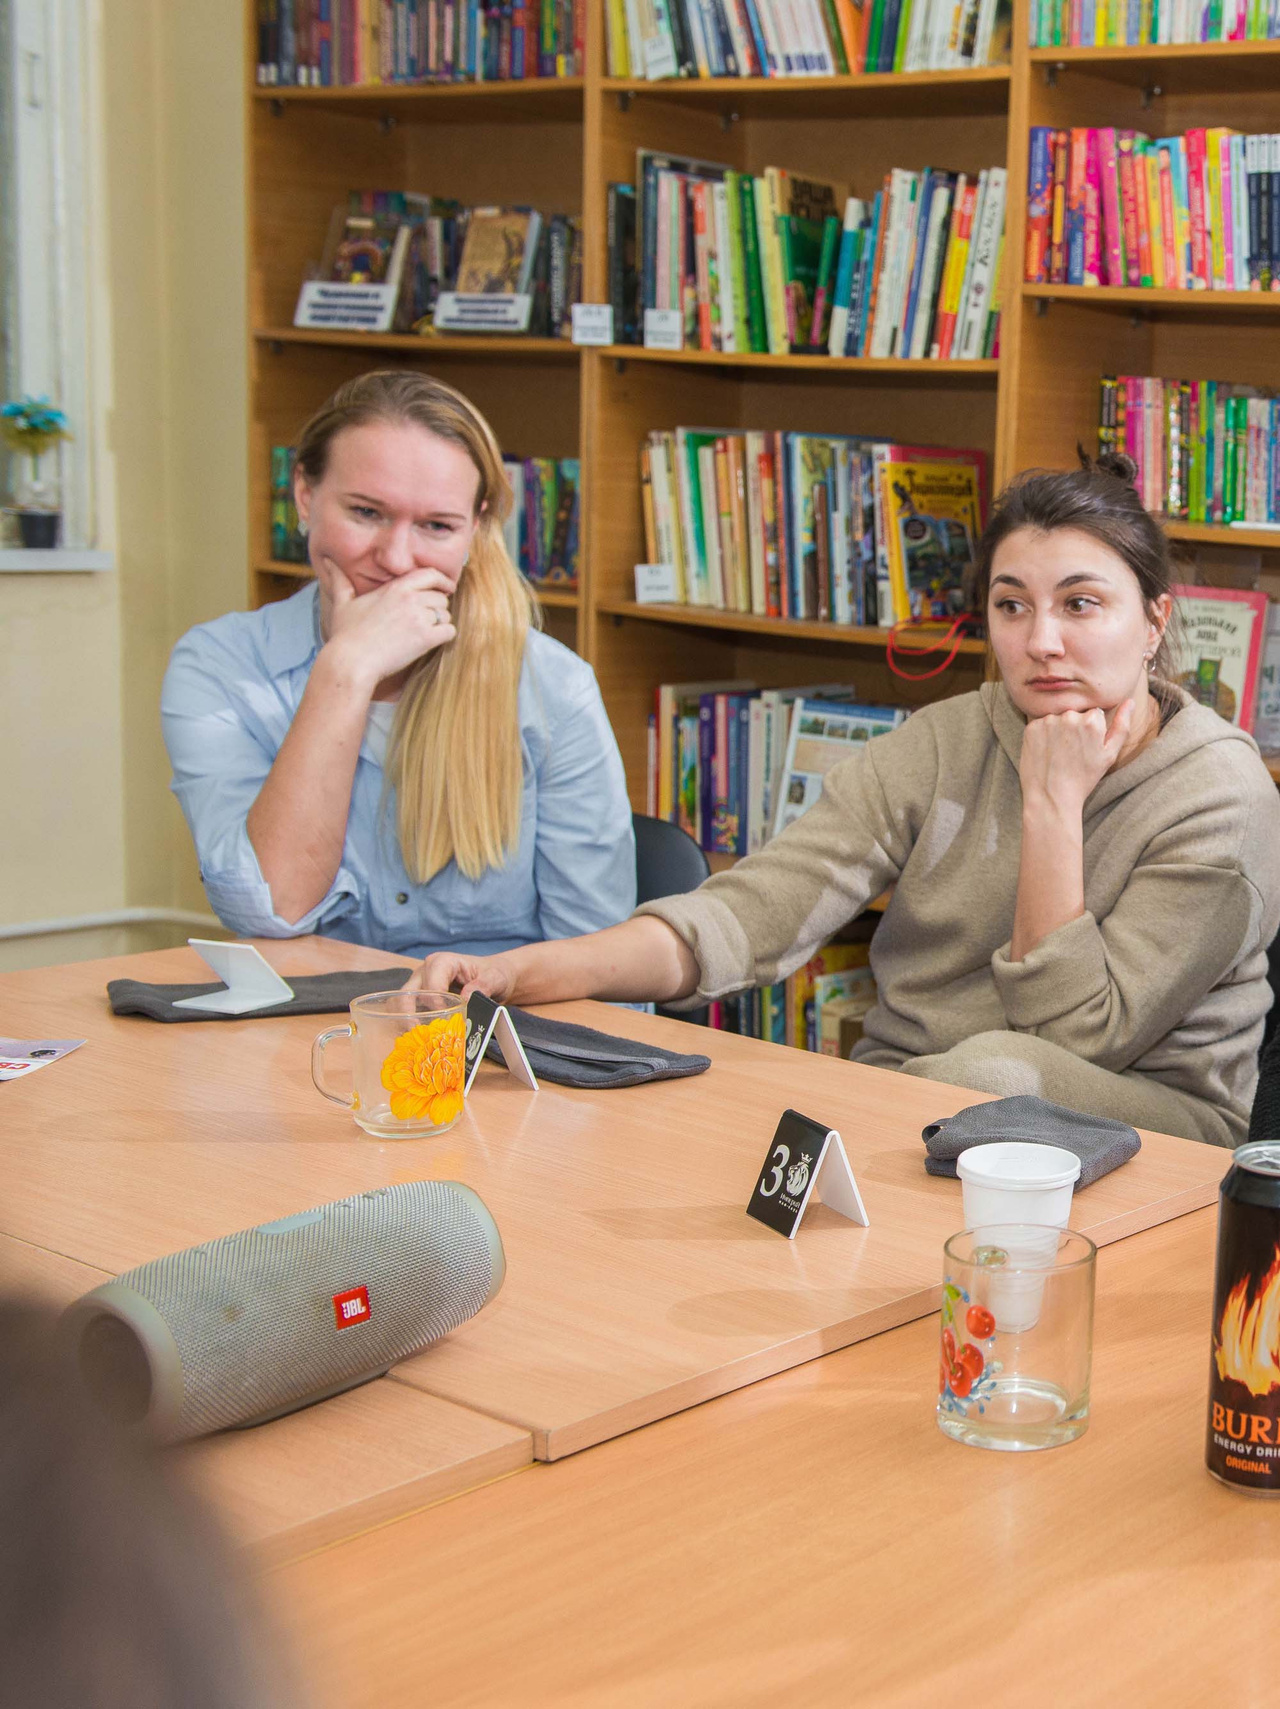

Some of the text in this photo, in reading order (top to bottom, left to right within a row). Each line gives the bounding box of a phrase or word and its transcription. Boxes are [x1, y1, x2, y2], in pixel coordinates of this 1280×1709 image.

[759, 1144, 790, 1197] 3
[341, 1297, 367, 1319] JBL
[1214, 1433, 1252, 1455] ENERGY
[1225, 1454, 1272, 1475] ORIGINAL
